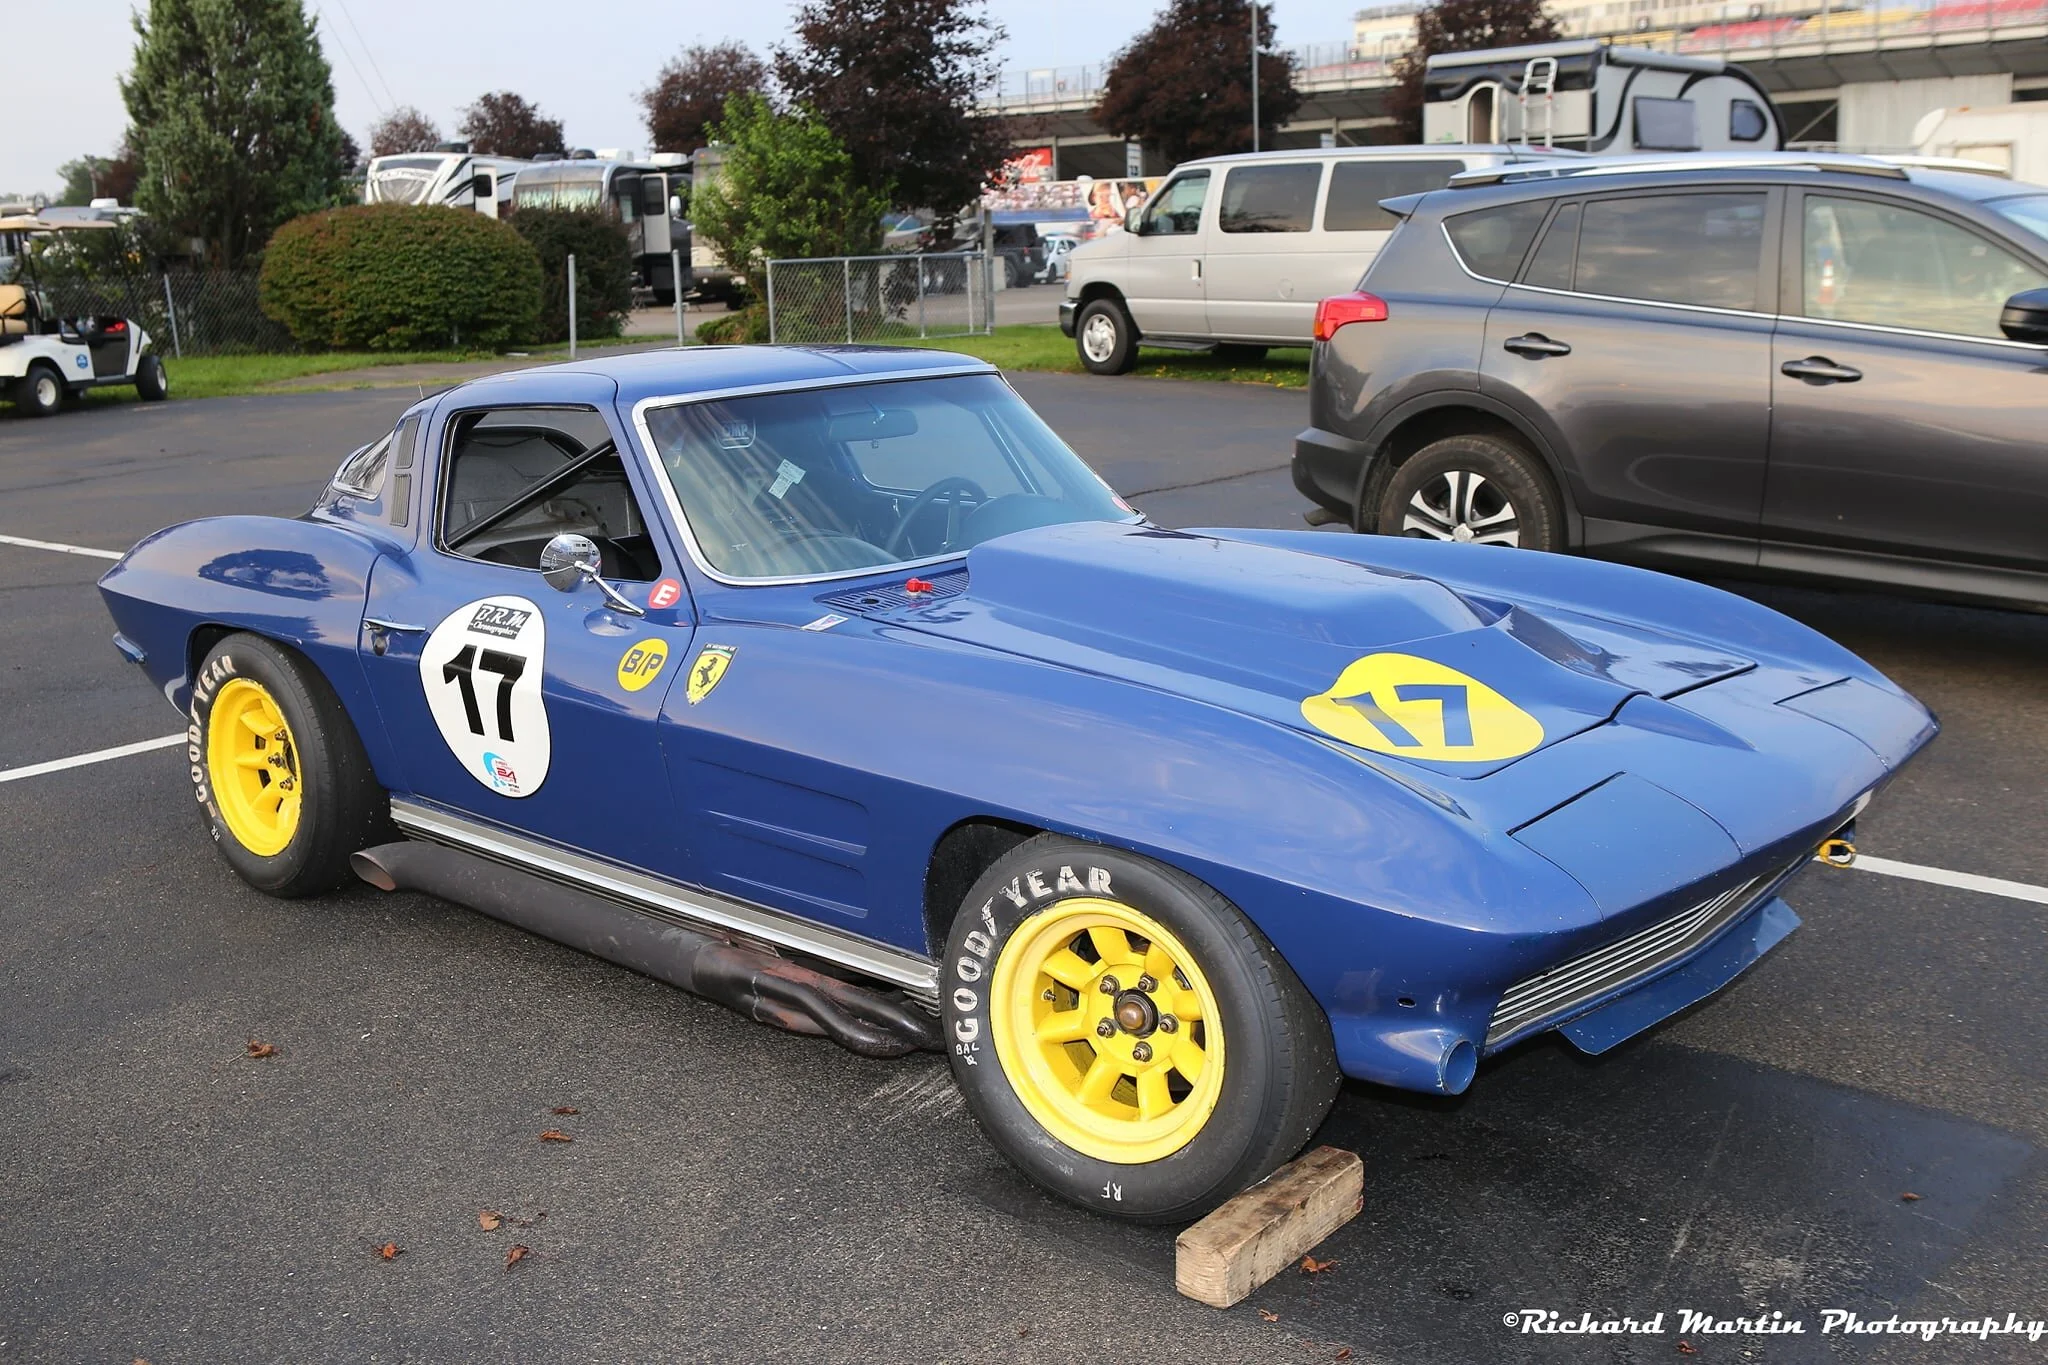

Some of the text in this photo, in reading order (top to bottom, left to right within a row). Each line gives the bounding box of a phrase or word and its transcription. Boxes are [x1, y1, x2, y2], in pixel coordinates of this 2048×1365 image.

[653, 584, 677, 606] E
[622, 649, 663, 677] B/P
[442, 643, 528, 744] 17
[1330, 684, 1475, 747] 17
[955, 1042, 980, 1056] BAL
[1100, 1180, 1122, 1202] RF
